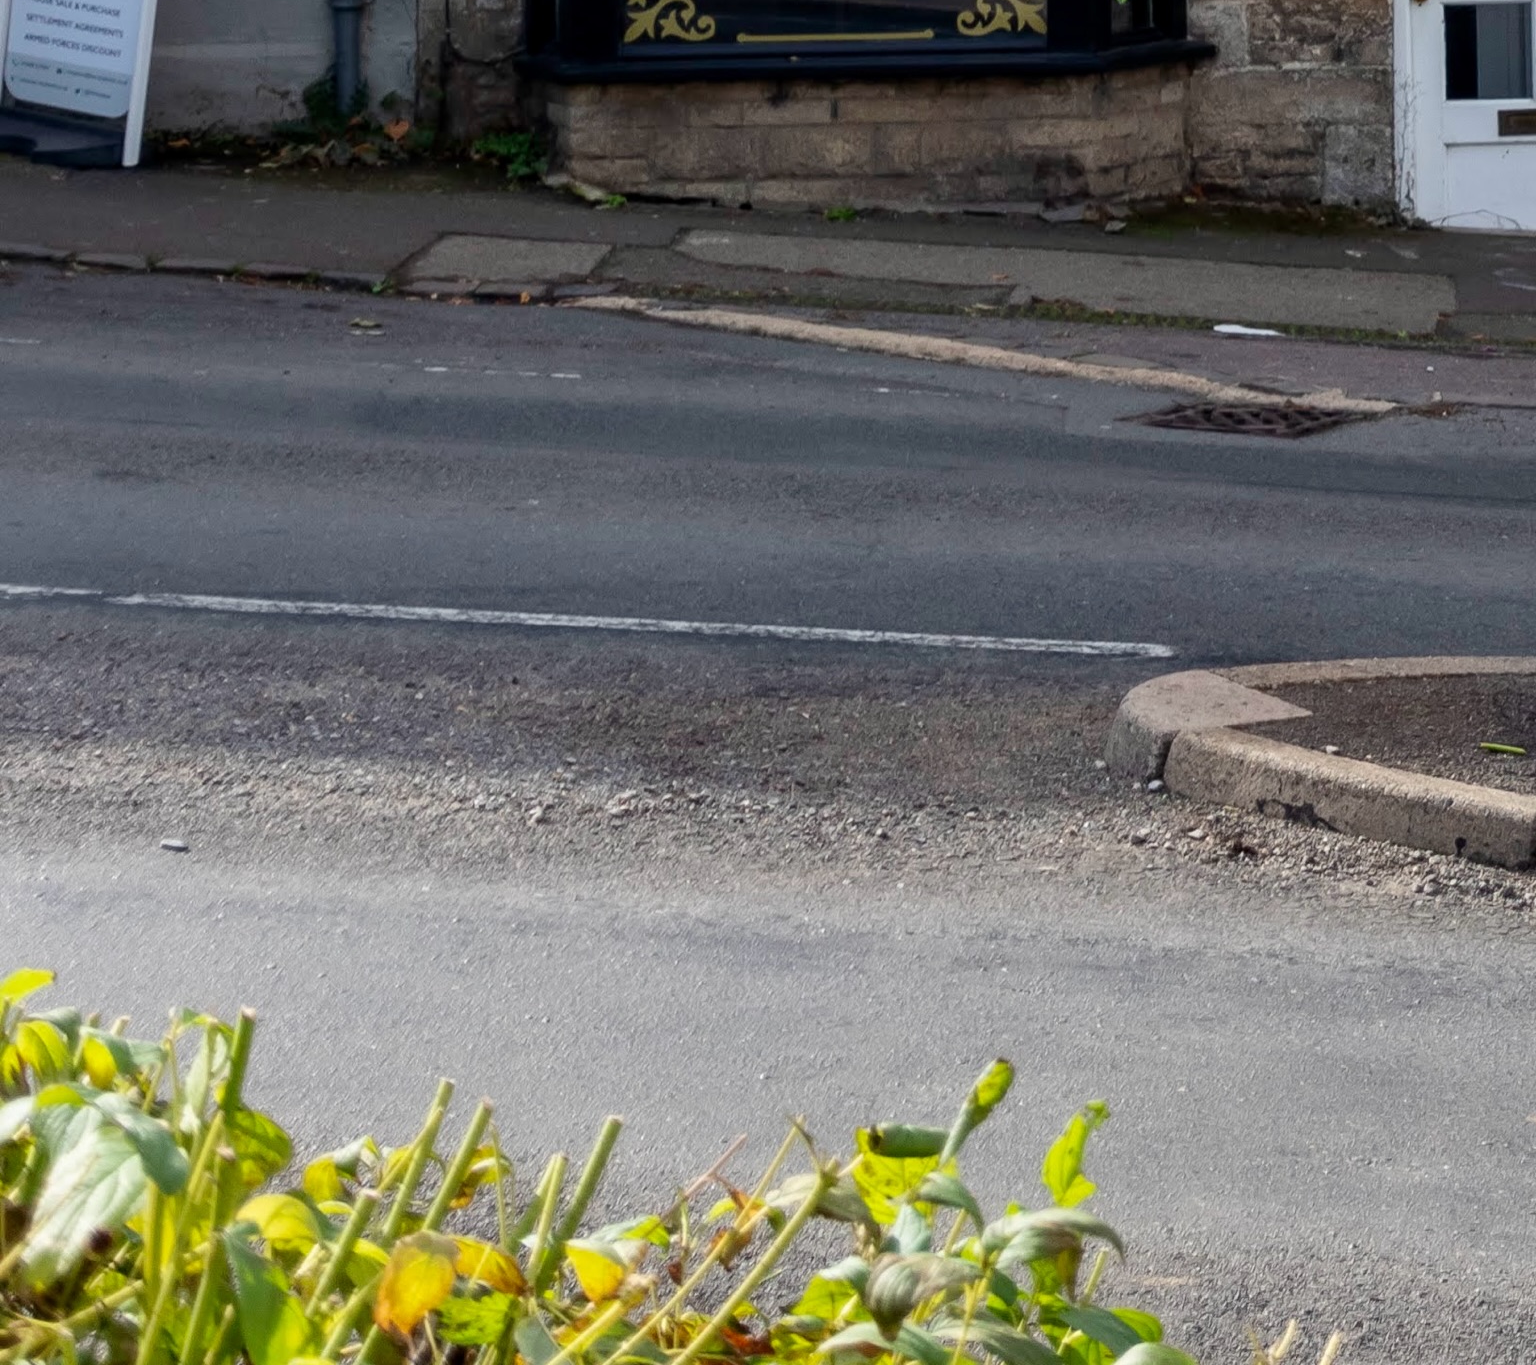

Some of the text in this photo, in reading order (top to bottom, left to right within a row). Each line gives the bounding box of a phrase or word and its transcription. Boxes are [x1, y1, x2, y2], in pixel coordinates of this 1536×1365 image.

[81, 3, 121, 17] PURCHASE
[26, 13, 124, 39] SETTLEMENT AGREEMENTS
[24, 33, 122, 58] ARMED FORCES DISCOUNT
